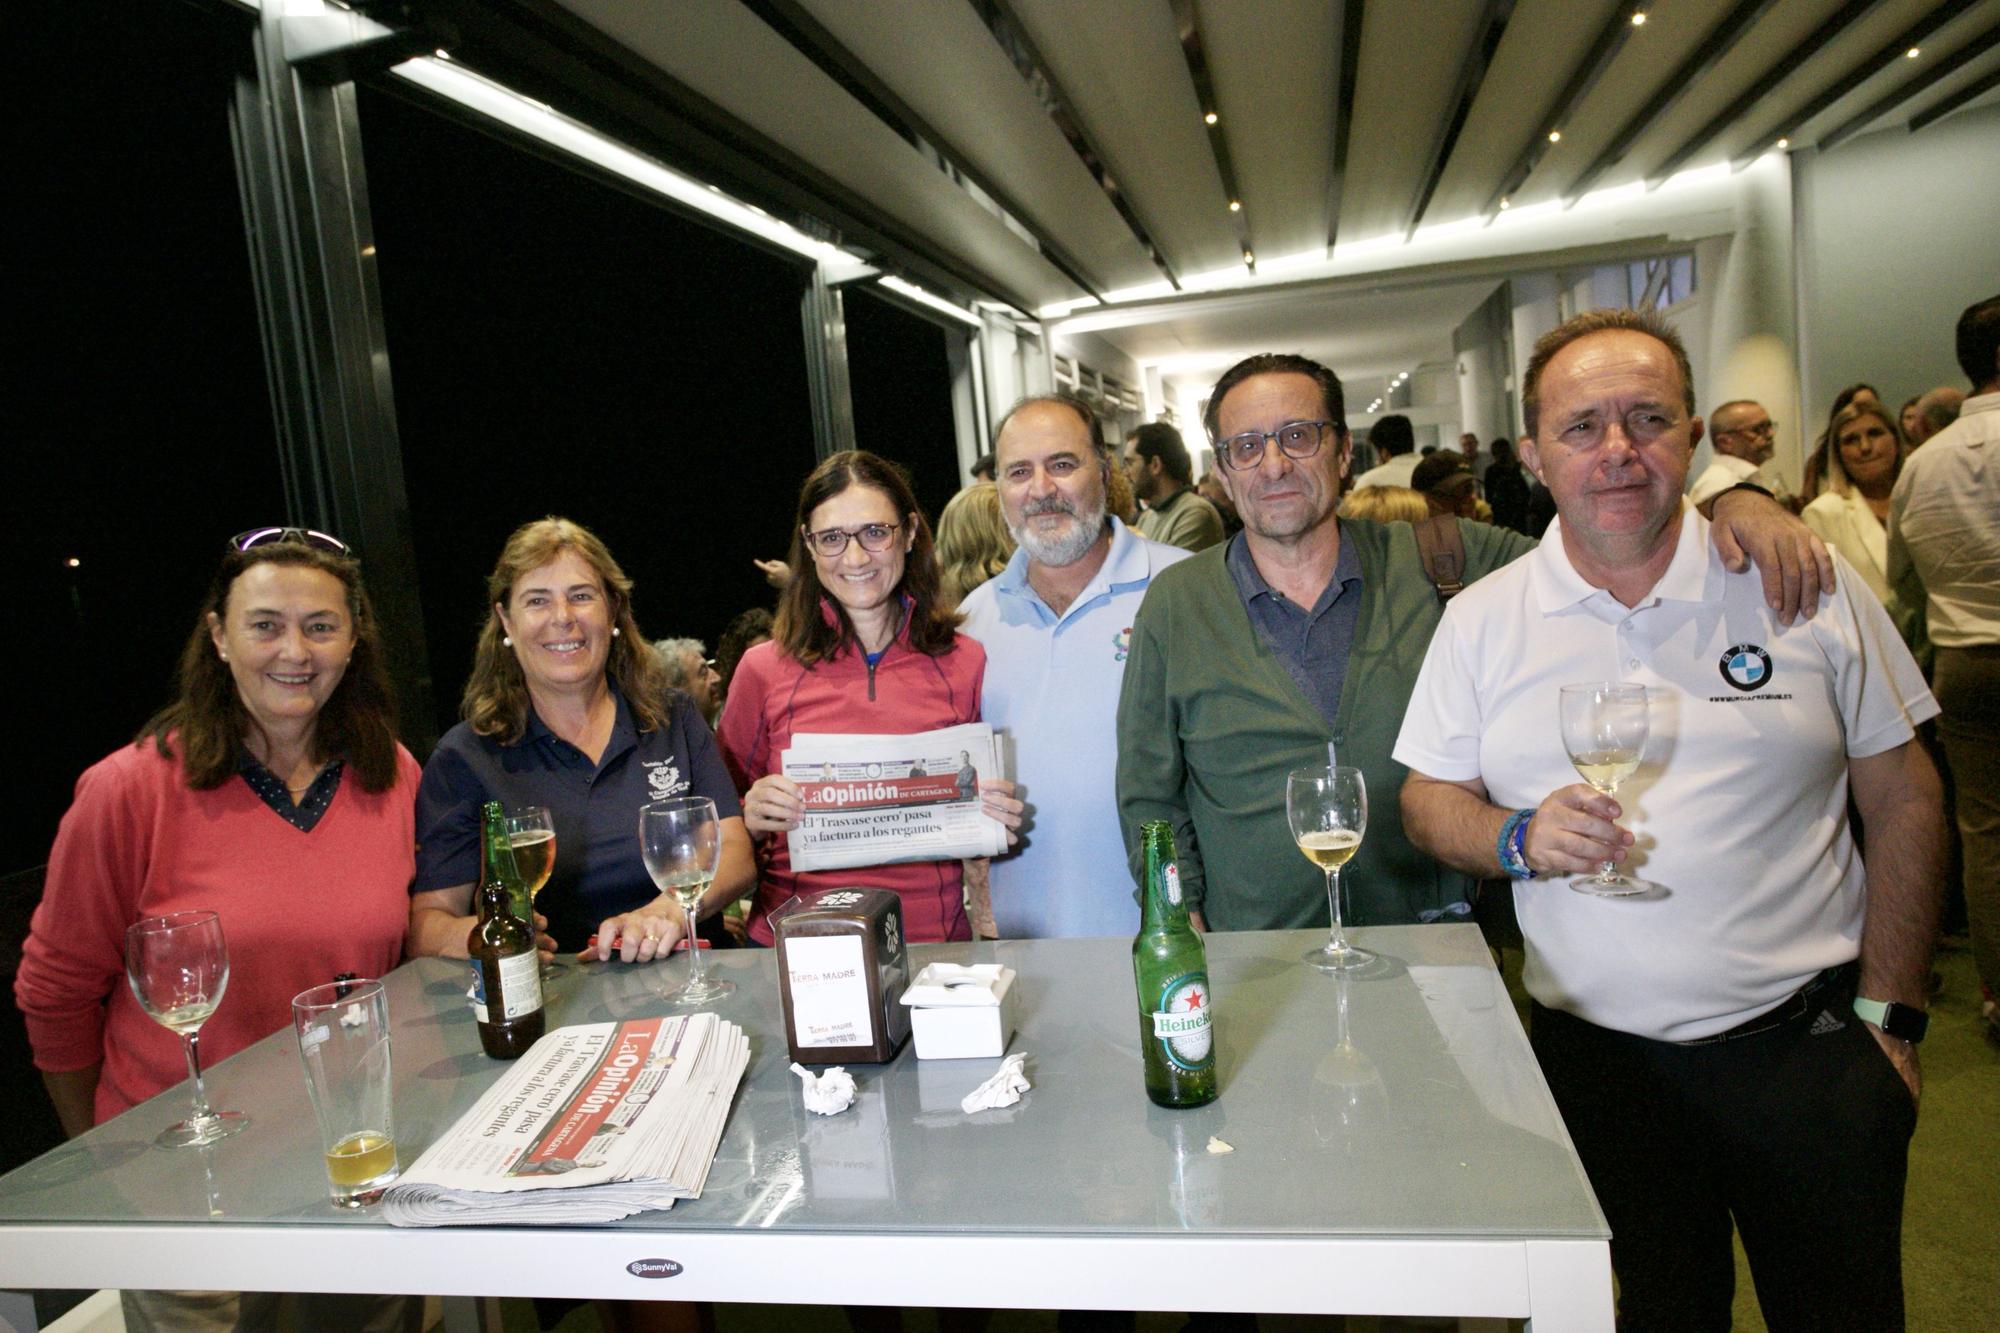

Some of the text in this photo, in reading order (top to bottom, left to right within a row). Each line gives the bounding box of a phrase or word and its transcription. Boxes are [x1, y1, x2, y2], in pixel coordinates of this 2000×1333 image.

[1721, 644, 1767, 663] BMW
[911, 788, 953, 798] CARTAGENA
[803, 815, 814, 828] El
[904, 811, 932, 824] pasa
[803, 834, 817, 845] ya
[820, 831, 862, 842] factura
[872, 827, 890, 838] los
[891, 825, 942, 838] regantes
[822, 969, 857, 982] MADRE
[562, 1035, 579, 1047] ya
[586, 1035, 605, 1045] El
[537, 1047, 575, 1076] factura
[519, 1082, 545, 1096] los
[482, 1096, 527, 1138] regantes
[514, 1110, 543, 1134] pasa
[541, 1121, 577, 1156] CARTAGENA
[641, 1263, 677, 1272] SunnyVal
